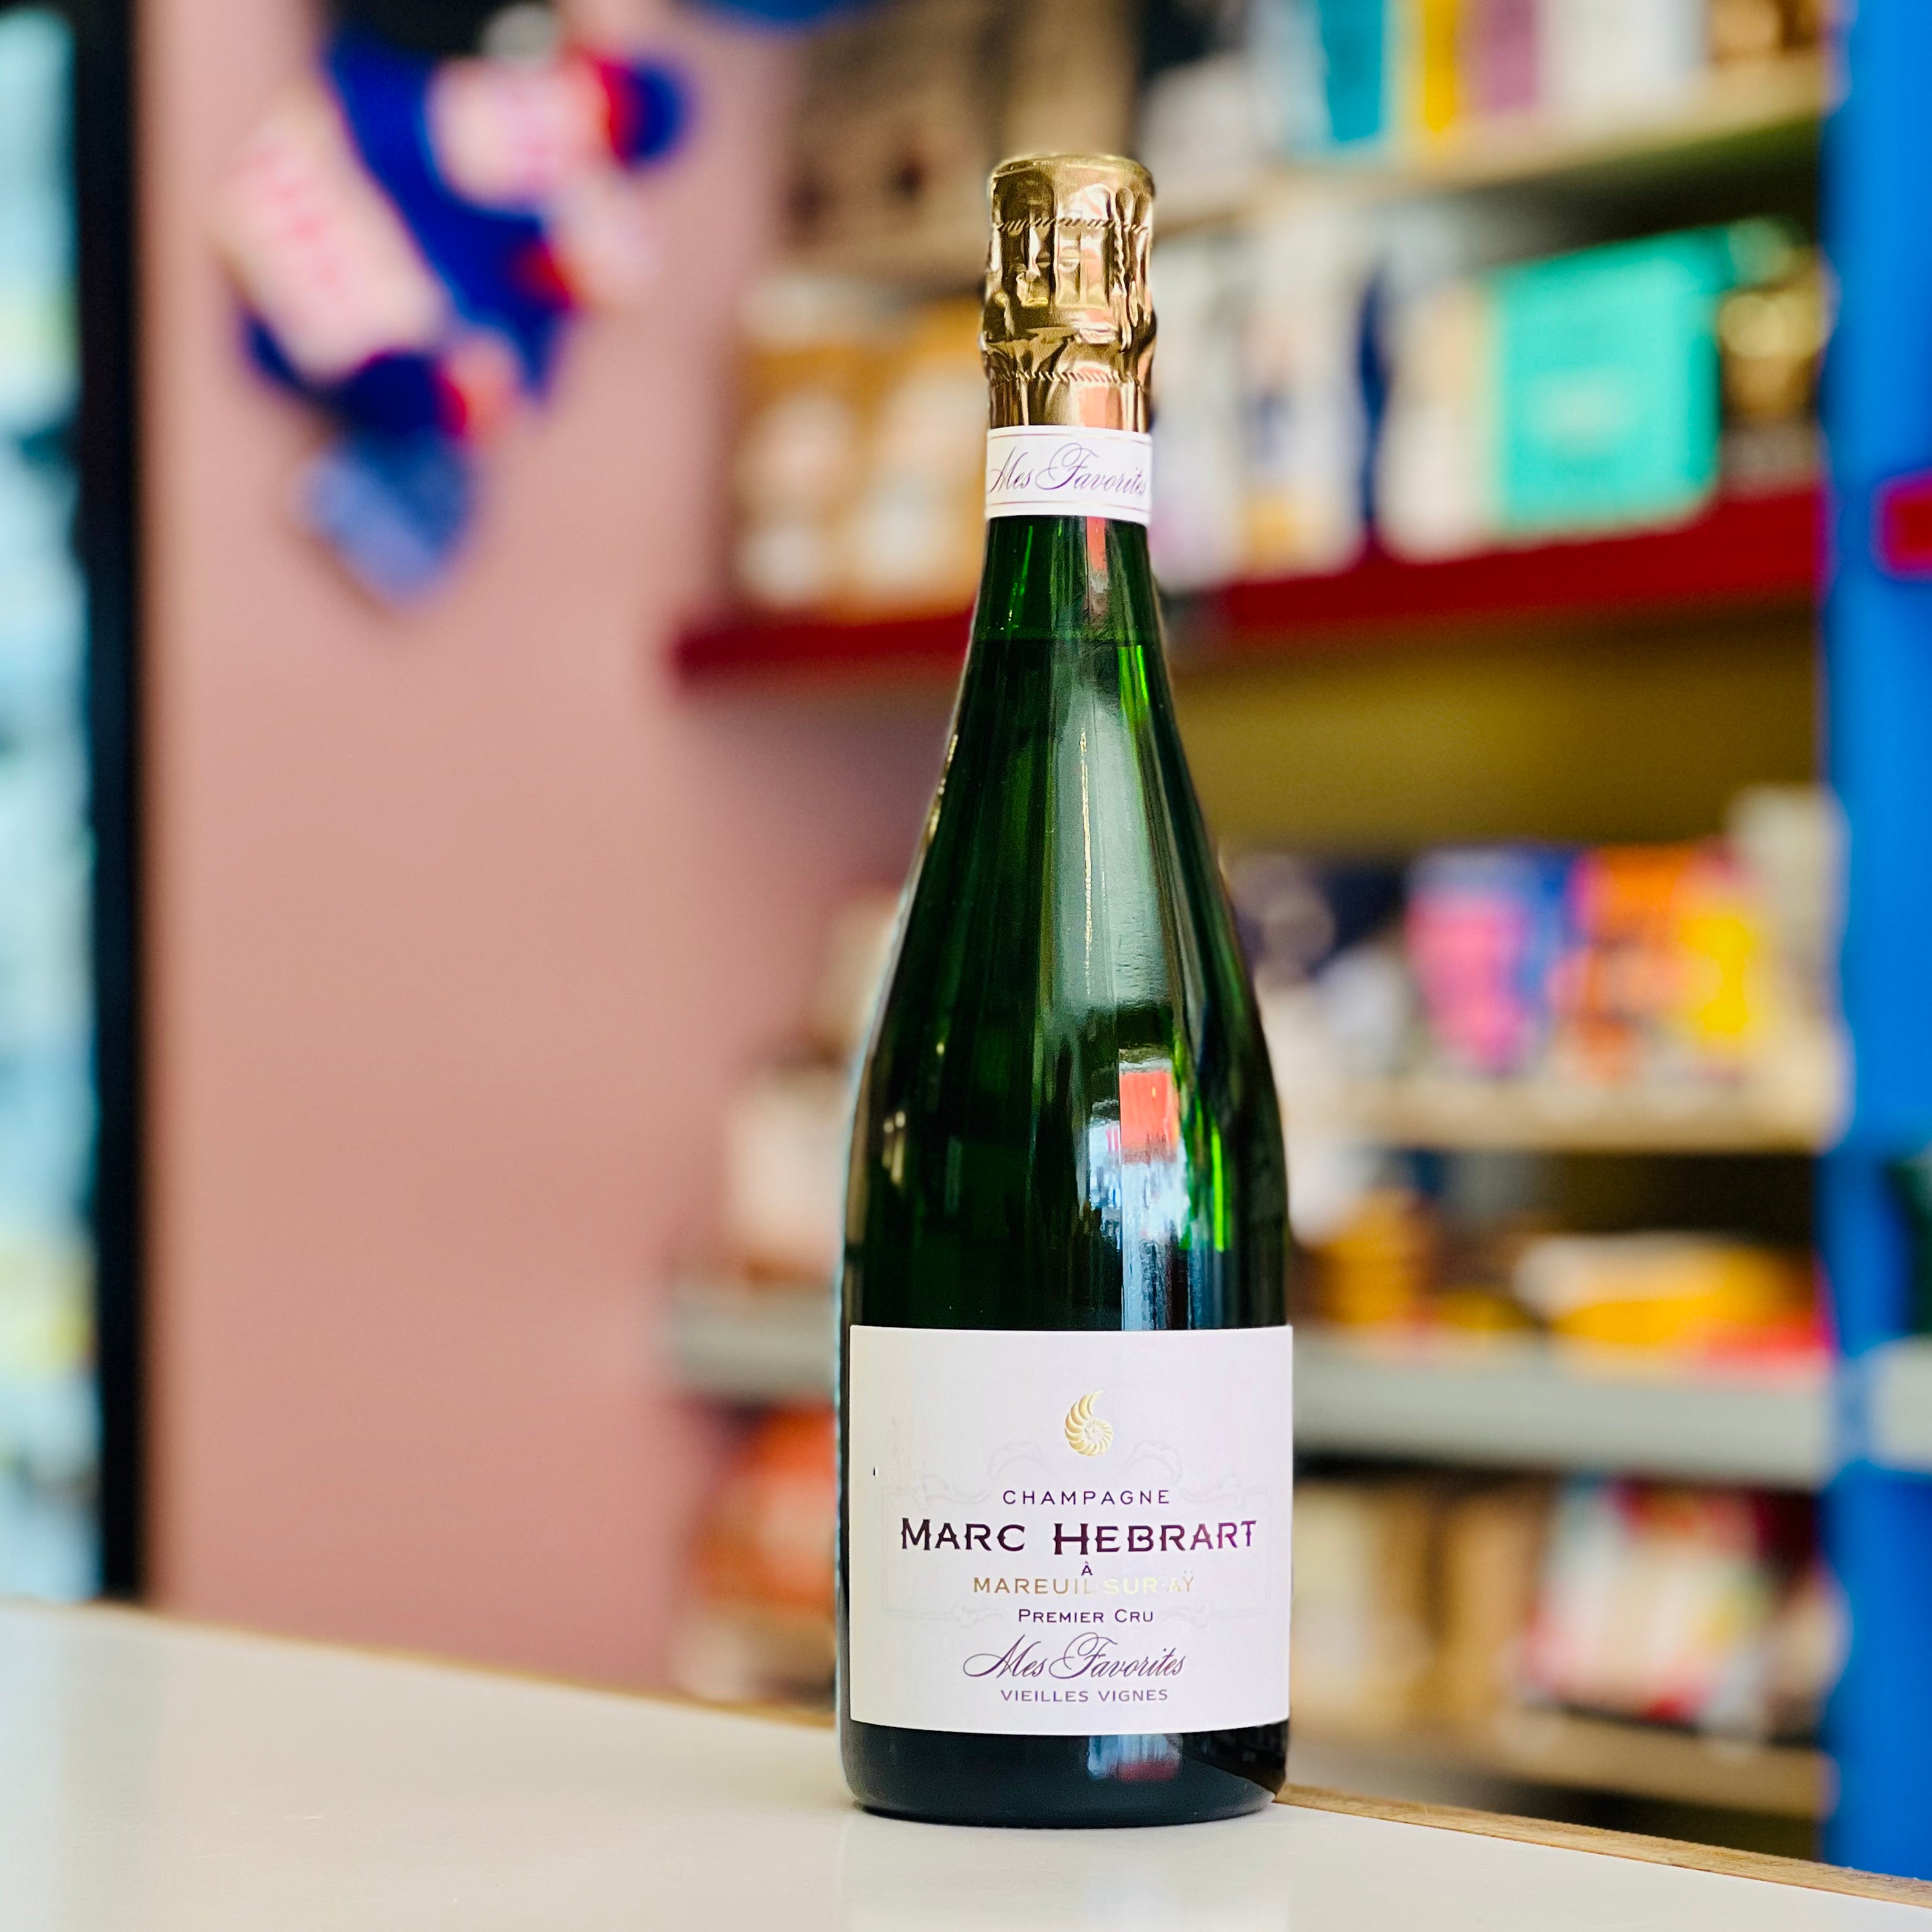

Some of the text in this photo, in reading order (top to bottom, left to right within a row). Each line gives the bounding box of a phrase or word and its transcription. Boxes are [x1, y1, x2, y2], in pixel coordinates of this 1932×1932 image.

[988, 442, 1146, 496] Mes Favorites
[1003, 1489, 1170, 1505] CHAMPAGNE
[900, 1517, 1257, 1556] MARC HEBRART
[1018, 1608, 1153, 1623] PREMIER CRU
[963, 1632, 1186, 1679] Mes Favorites
[1001, 1689, 1168, 1702] VIEILLES VIGNES
